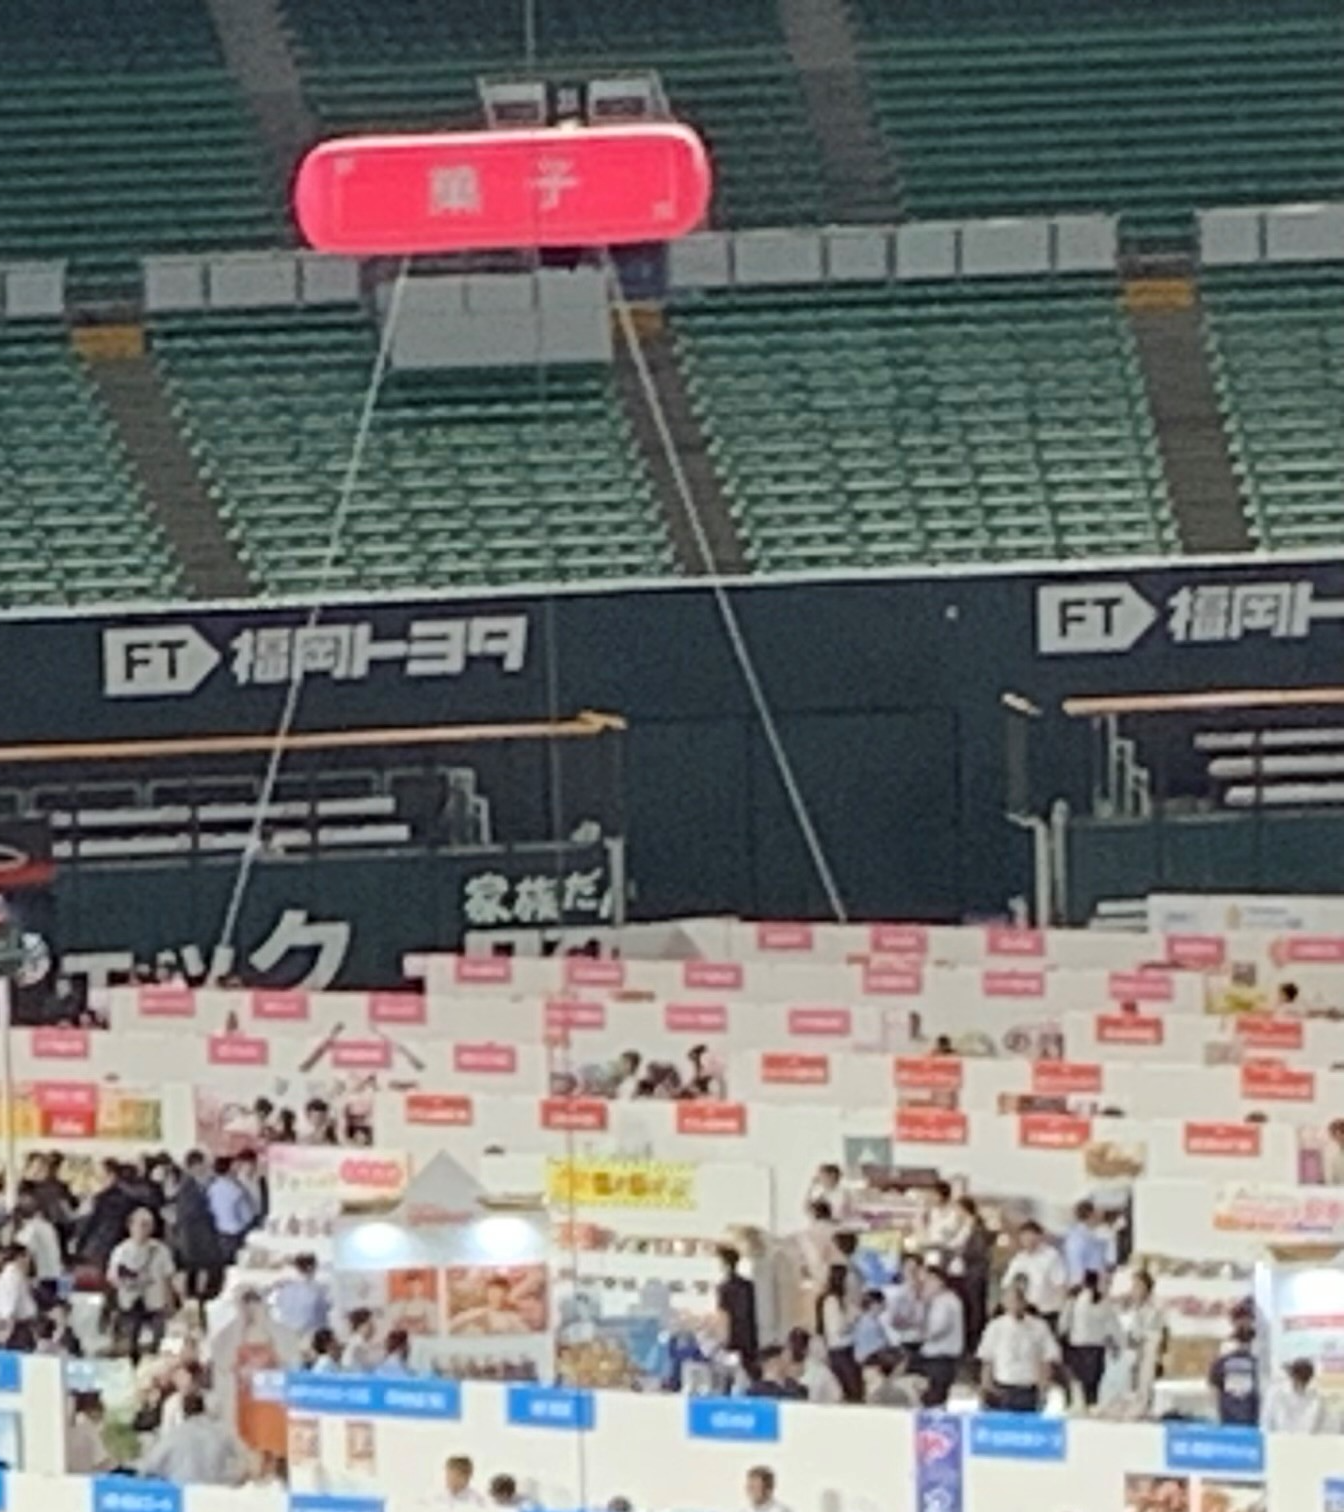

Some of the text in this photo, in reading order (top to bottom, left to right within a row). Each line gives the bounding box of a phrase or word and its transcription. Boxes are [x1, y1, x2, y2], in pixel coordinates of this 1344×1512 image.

[1059, 599, 1122, 638] FT
[124, 614, 529, 685] FT 福岡トヨタ
